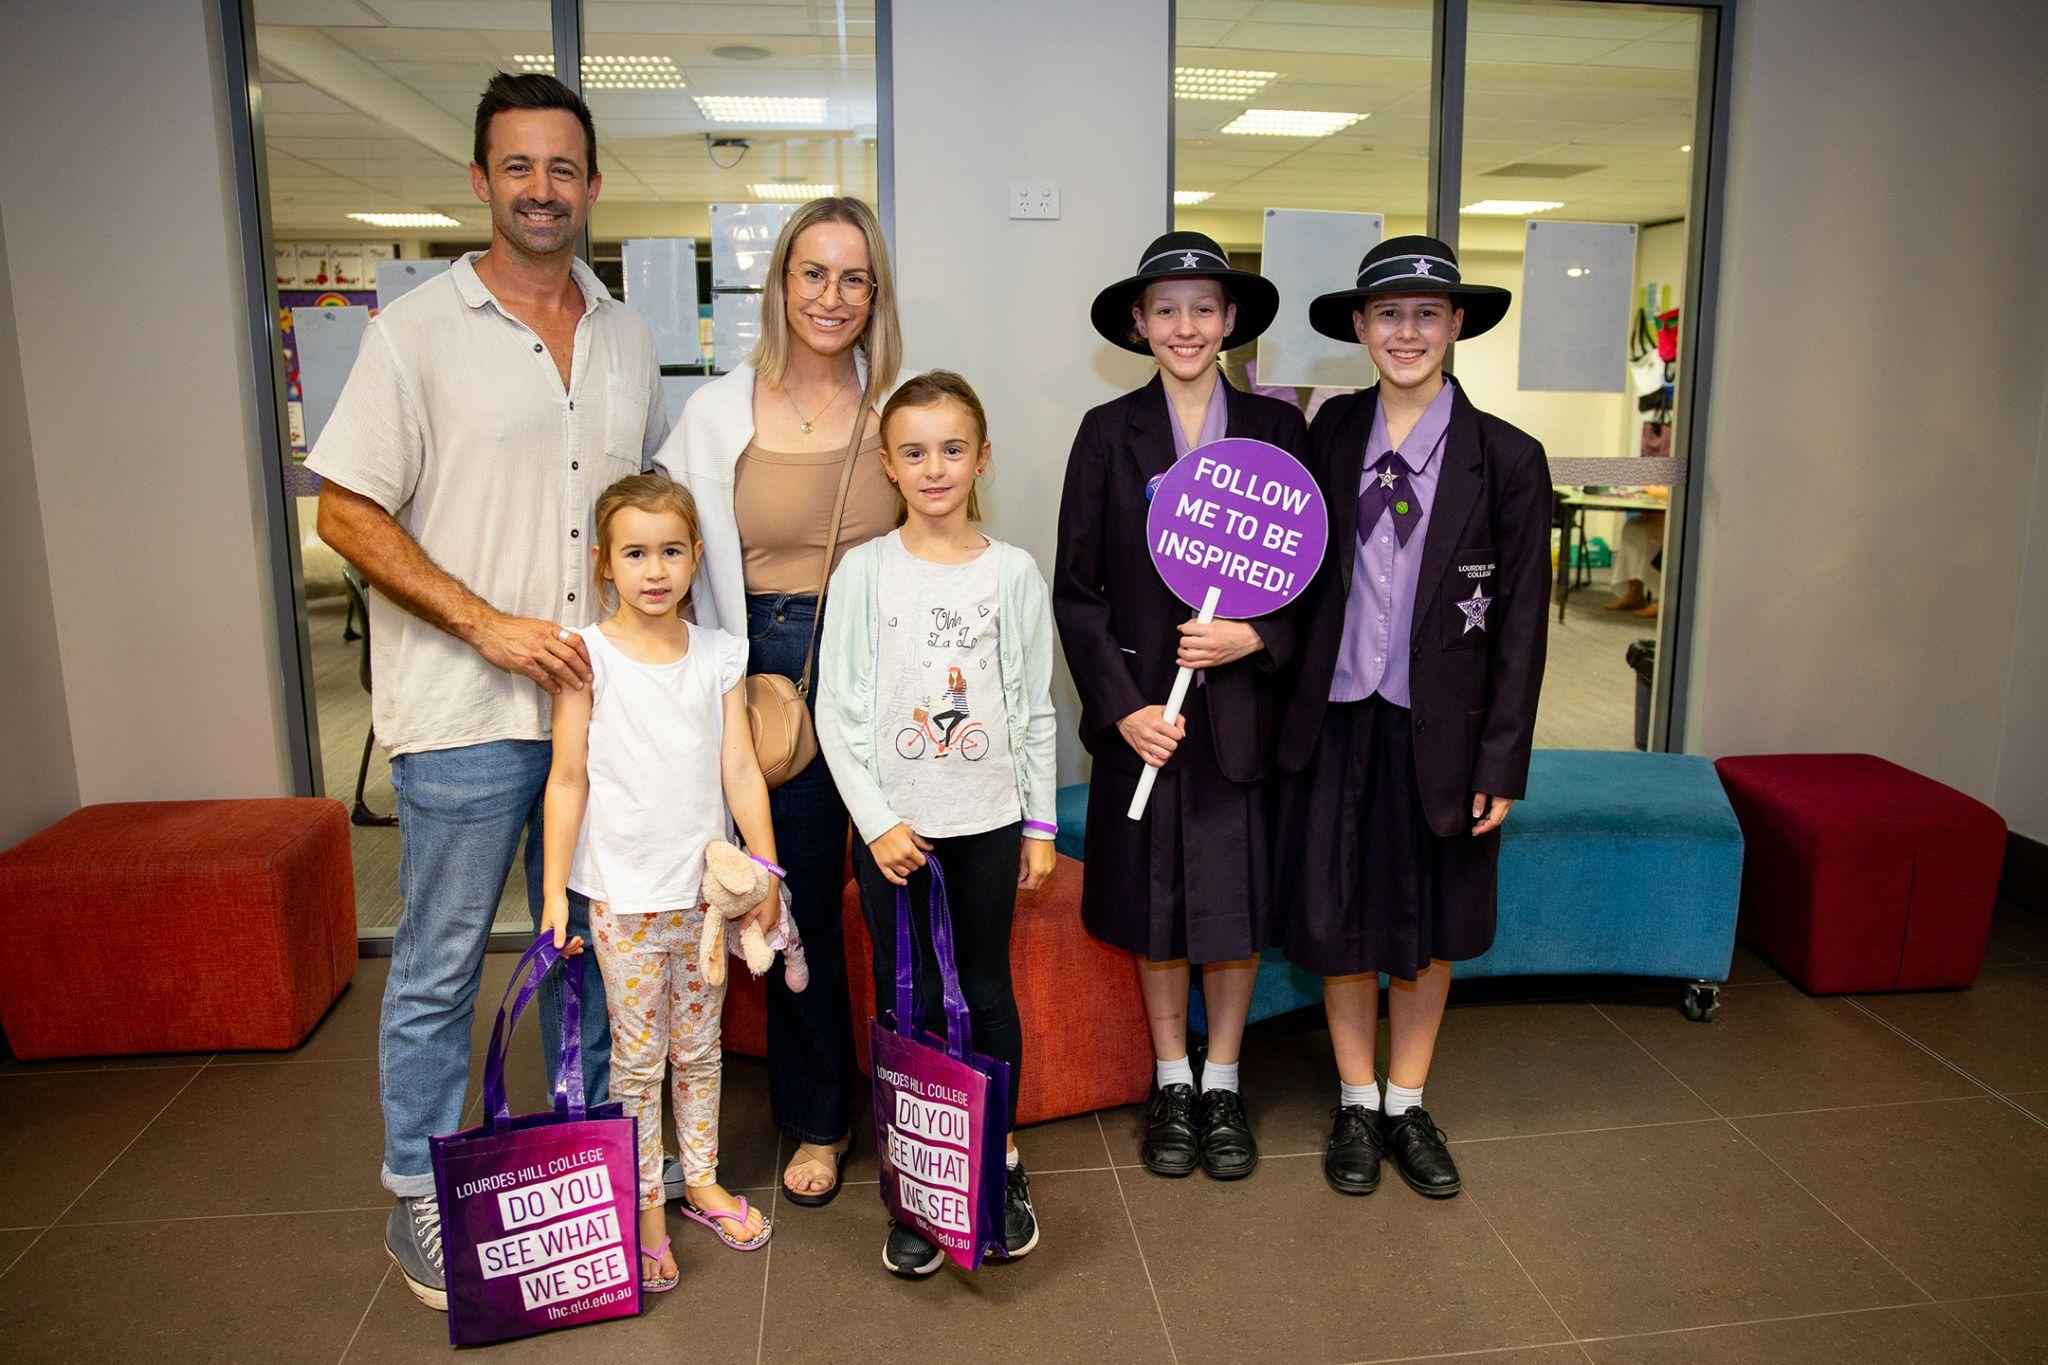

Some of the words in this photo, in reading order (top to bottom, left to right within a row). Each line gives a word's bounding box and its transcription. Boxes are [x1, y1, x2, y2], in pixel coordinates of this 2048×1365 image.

[1193, 456, 1312, 516] FOLLOW
[1175, 493, 1221, 529] ME
[1225, 508, 1258, 541] TO
[1262, 523, 1303, 557] BE
[1156, 529, 1295, 597] INSPIRED!
[910, 1077, 925, 1096] HILL
[928, 1083, 968, 1107] COLLEGE
[900, 1098, 920, 1129] DO
[925, 1107, 964, 1140] YOU
[456, 1172, 516, 1199] LOURDES
[518, 1169, 547, 1183] HILL
[548, 1147, 605, 1174] COLLEGE
[890, 1131, 908, 1167] SEE
[911, 1145, 965, 1183] WHAT
[508, 1191, 545, 1223] DO
[551, 1172, 603, 1209] YOU
[902, 1180, 926, 1213] WE
[928, 1194, 965, 1226] SEE
[485, 1237, 535, 1271] SEE
[538, 1213, 611, 1257] WHAT
[525, 1270, 570, 1302] WE
[573, 1253, 621, 1290] SEE
[548, 1287, 632, 1320] lhc.qld.edu.au
